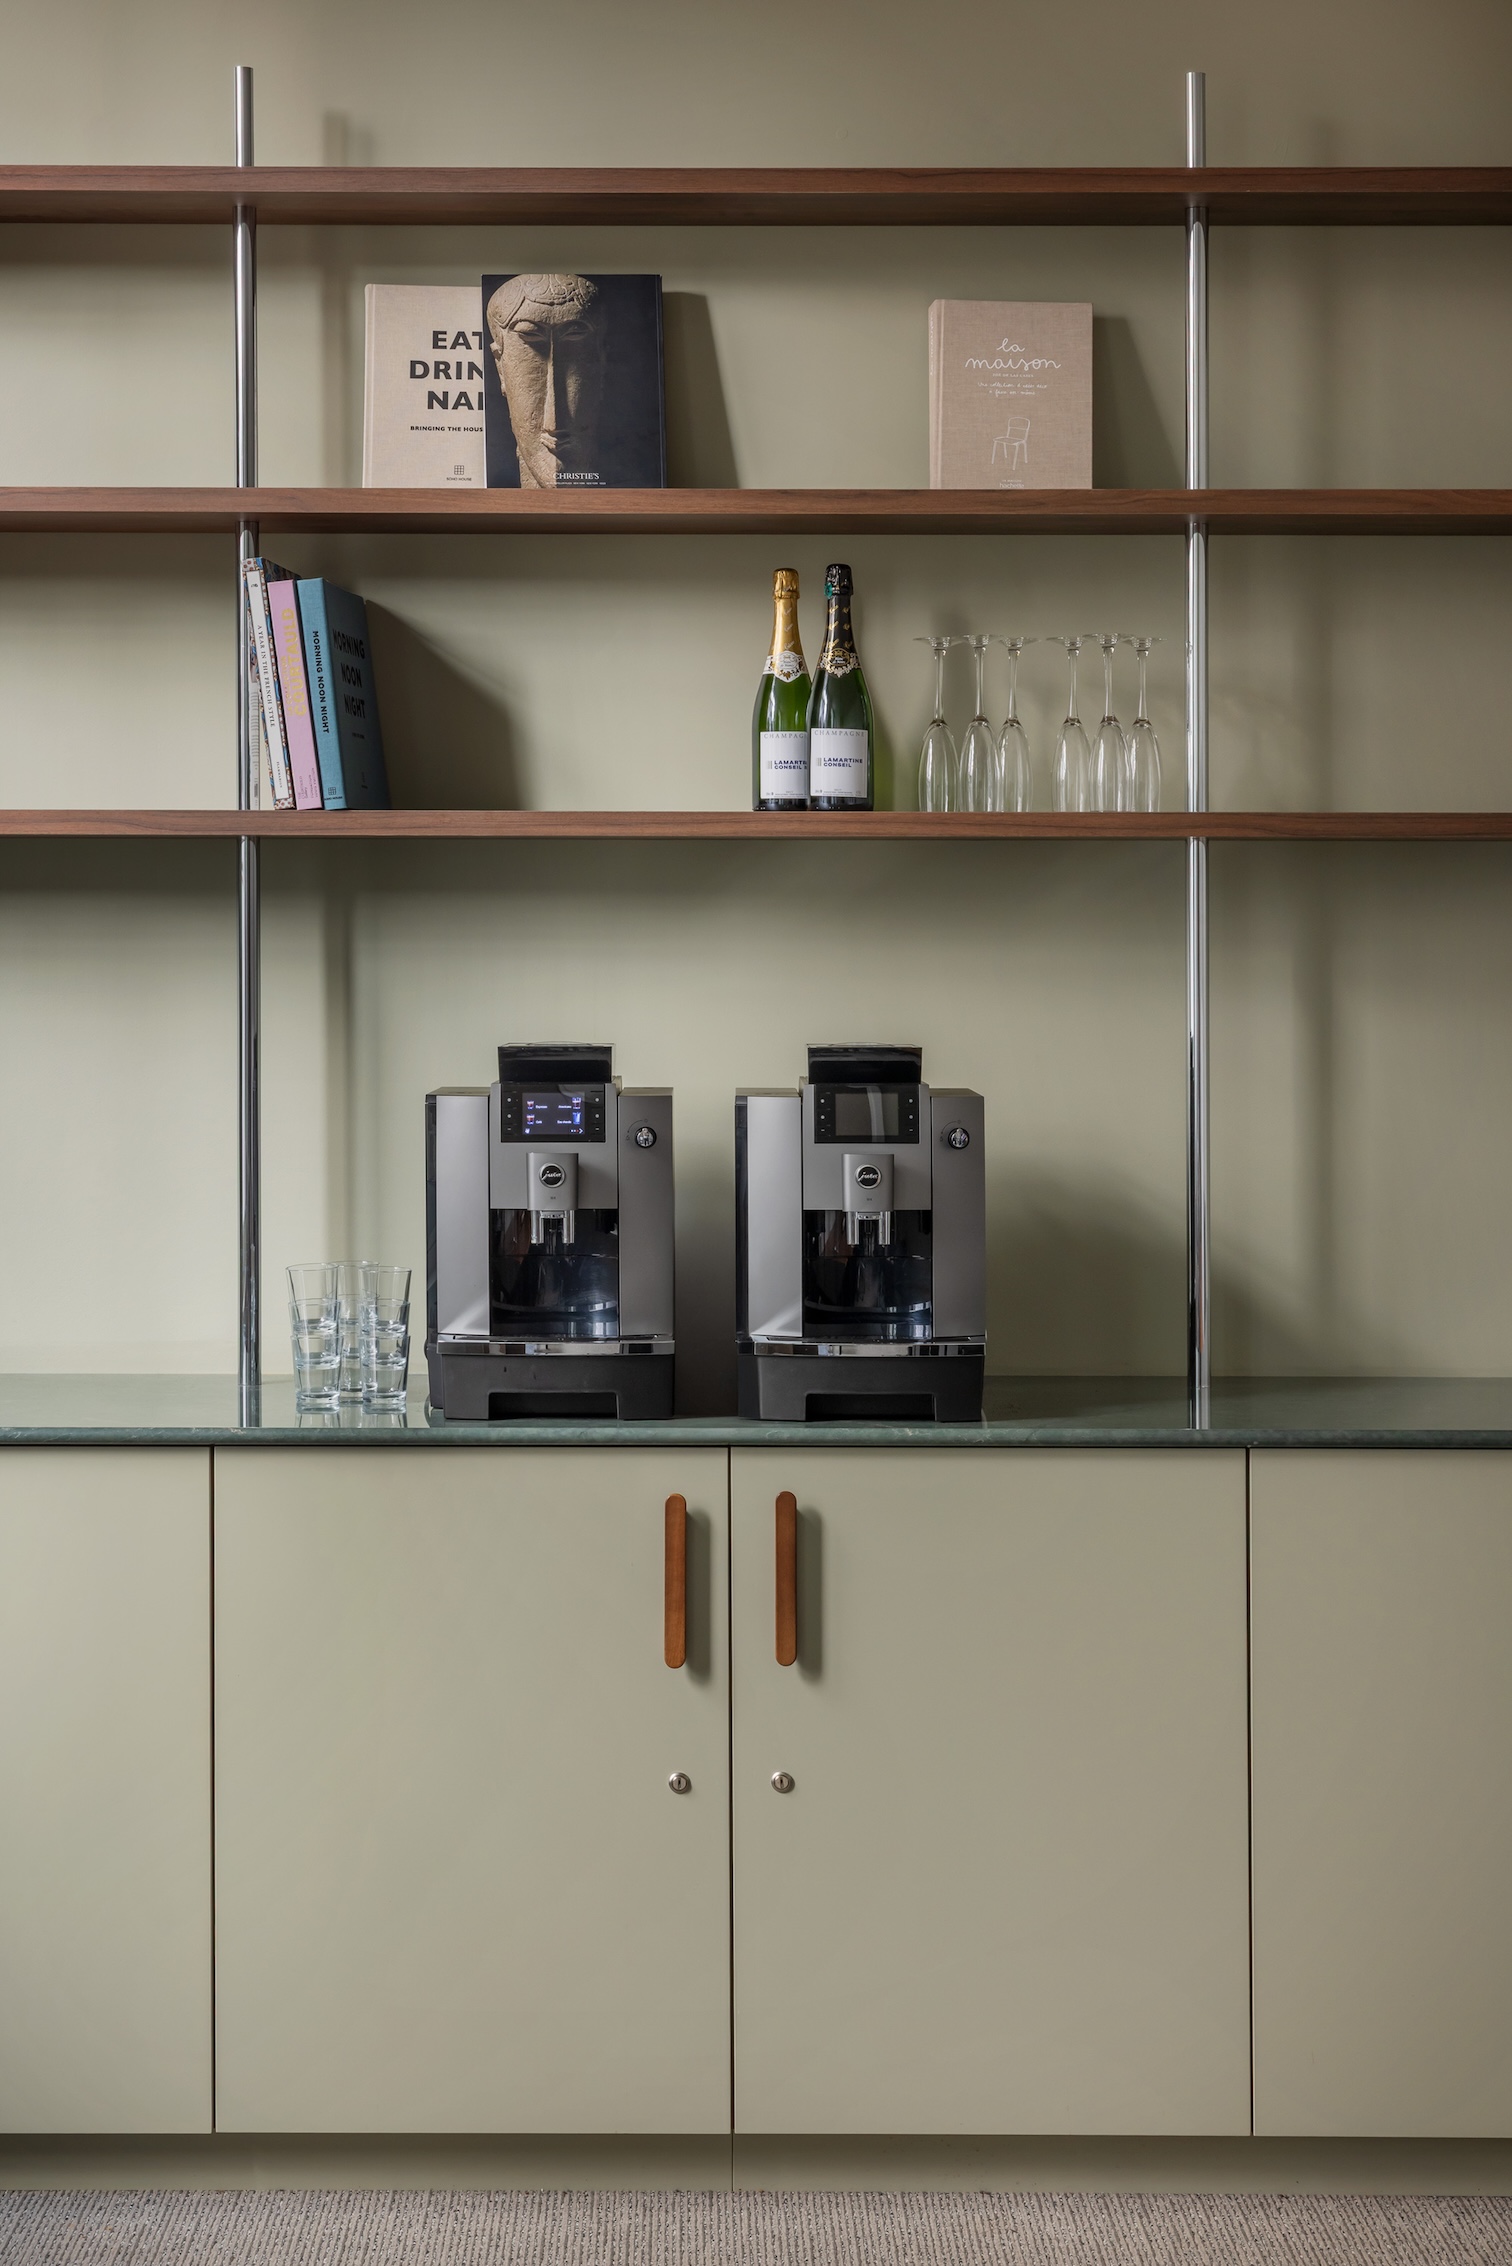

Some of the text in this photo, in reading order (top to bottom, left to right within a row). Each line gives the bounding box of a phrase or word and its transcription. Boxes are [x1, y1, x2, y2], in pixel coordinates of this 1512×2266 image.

[432, 330, 482, 350] EAT
[996, 337, 1025, 352] la
[410, 360, 483, 380] DRIN
[965, 354, 1061, 371] maison
[553, 472, 600, 480] CHRISTIE'S
[332, 628, 365, 659] MORNING
[282, 608, 307, 716] COURTAULD
[312, 630, 330, 734] MORNING NOON NIGHT
[340, 662, 363, 688] NOON
[261, 651, 267, 659] IN
[264, 677, 272, 704] FRENCH
[268, 705, 276, 727] STYLE
[343, 693, 366, 719] NIGHT
[814, 730, 865, 738] CHAMPAGNE
